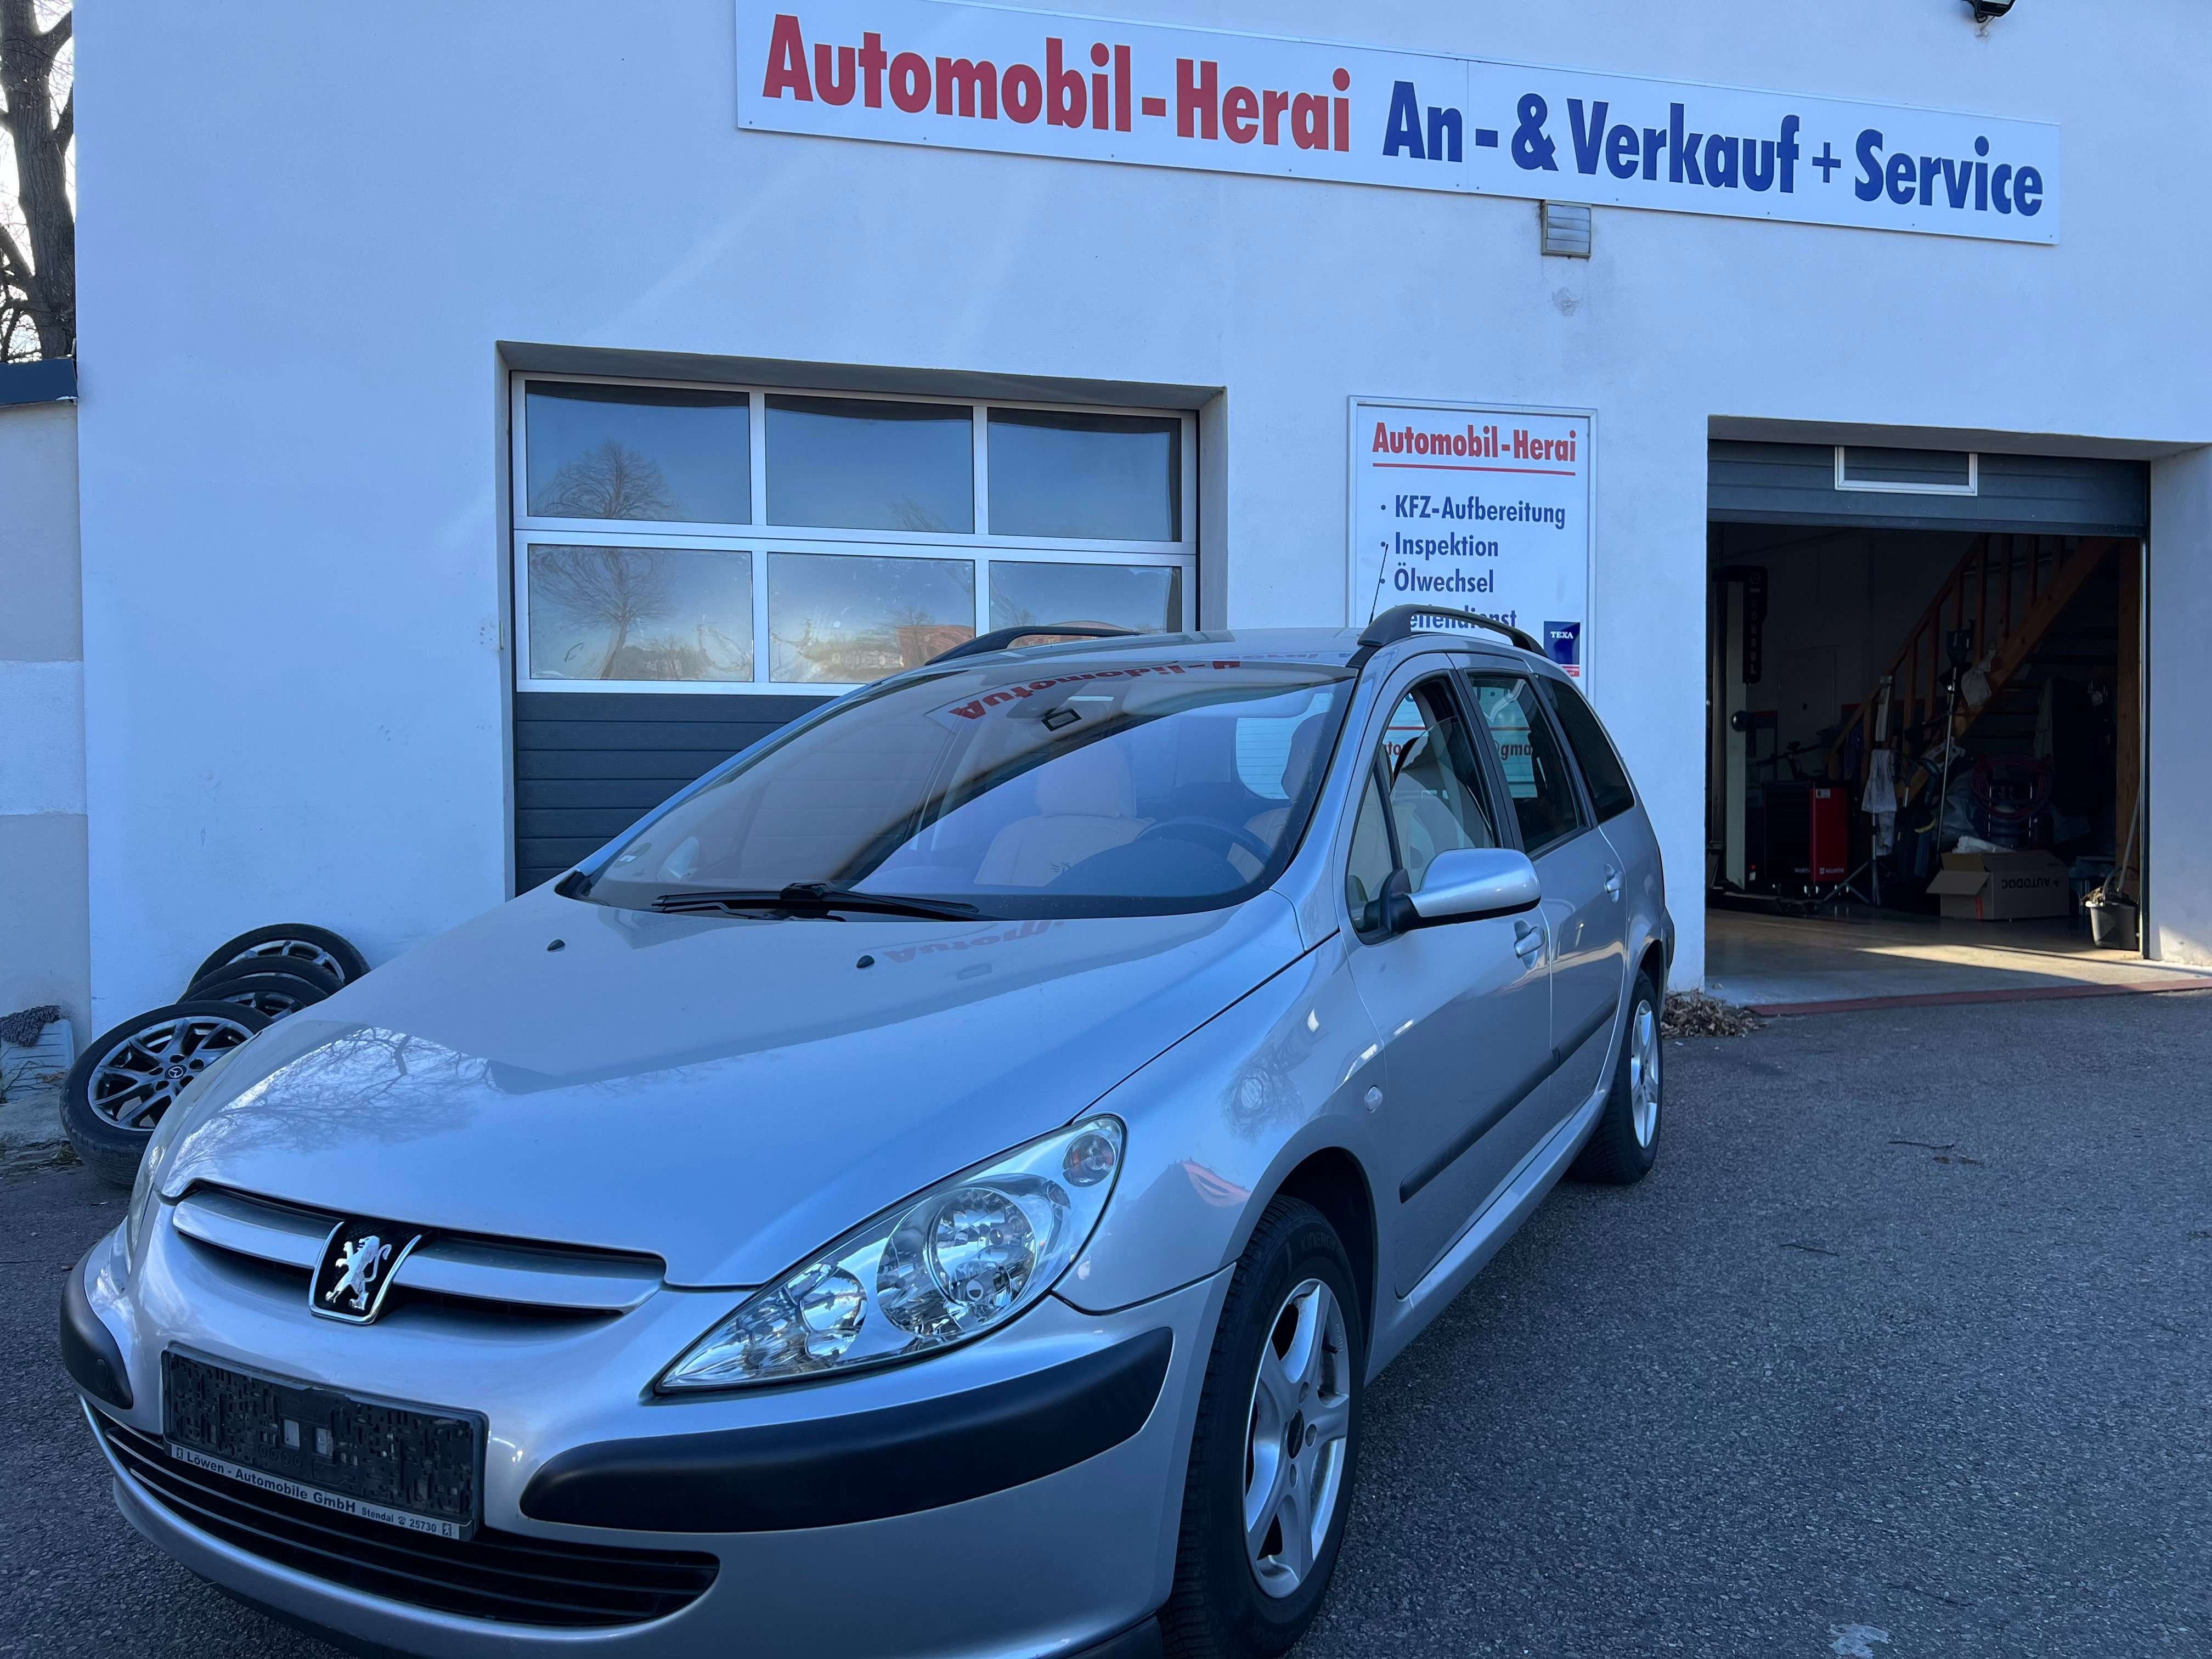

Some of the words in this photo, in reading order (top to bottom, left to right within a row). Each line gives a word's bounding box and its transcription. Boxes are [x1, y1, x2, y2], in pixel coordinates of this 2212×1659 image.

[763, 14, 1350, 153] Automobil-Herai
[1511, 92, 1559, 171] &
[1567, 98, 1801, 194] Verkauf
[1854, 128, 2044, 216] Service
[1372, 422, 1576, 462] Automobil-Herai
[1395, 494, 1565, 529] KFZ-Aufbereitung
[1395, 532, 1499, 561] Inspektion
[1393, 562, 1494, 593] Ölwechsel
[1550, 631, 1573, 639] TEXA
[2001, 877, 2051, 889] AUTODOC
[187, 1452, 224, 1474] Löwen
[235, 1468, 308, 1499] Automobile
[313, 1492, 356, 1513] GmbH
[362, 1507, 394, 1523] Stendal
[409, 1518, 437, 1533] 25730
